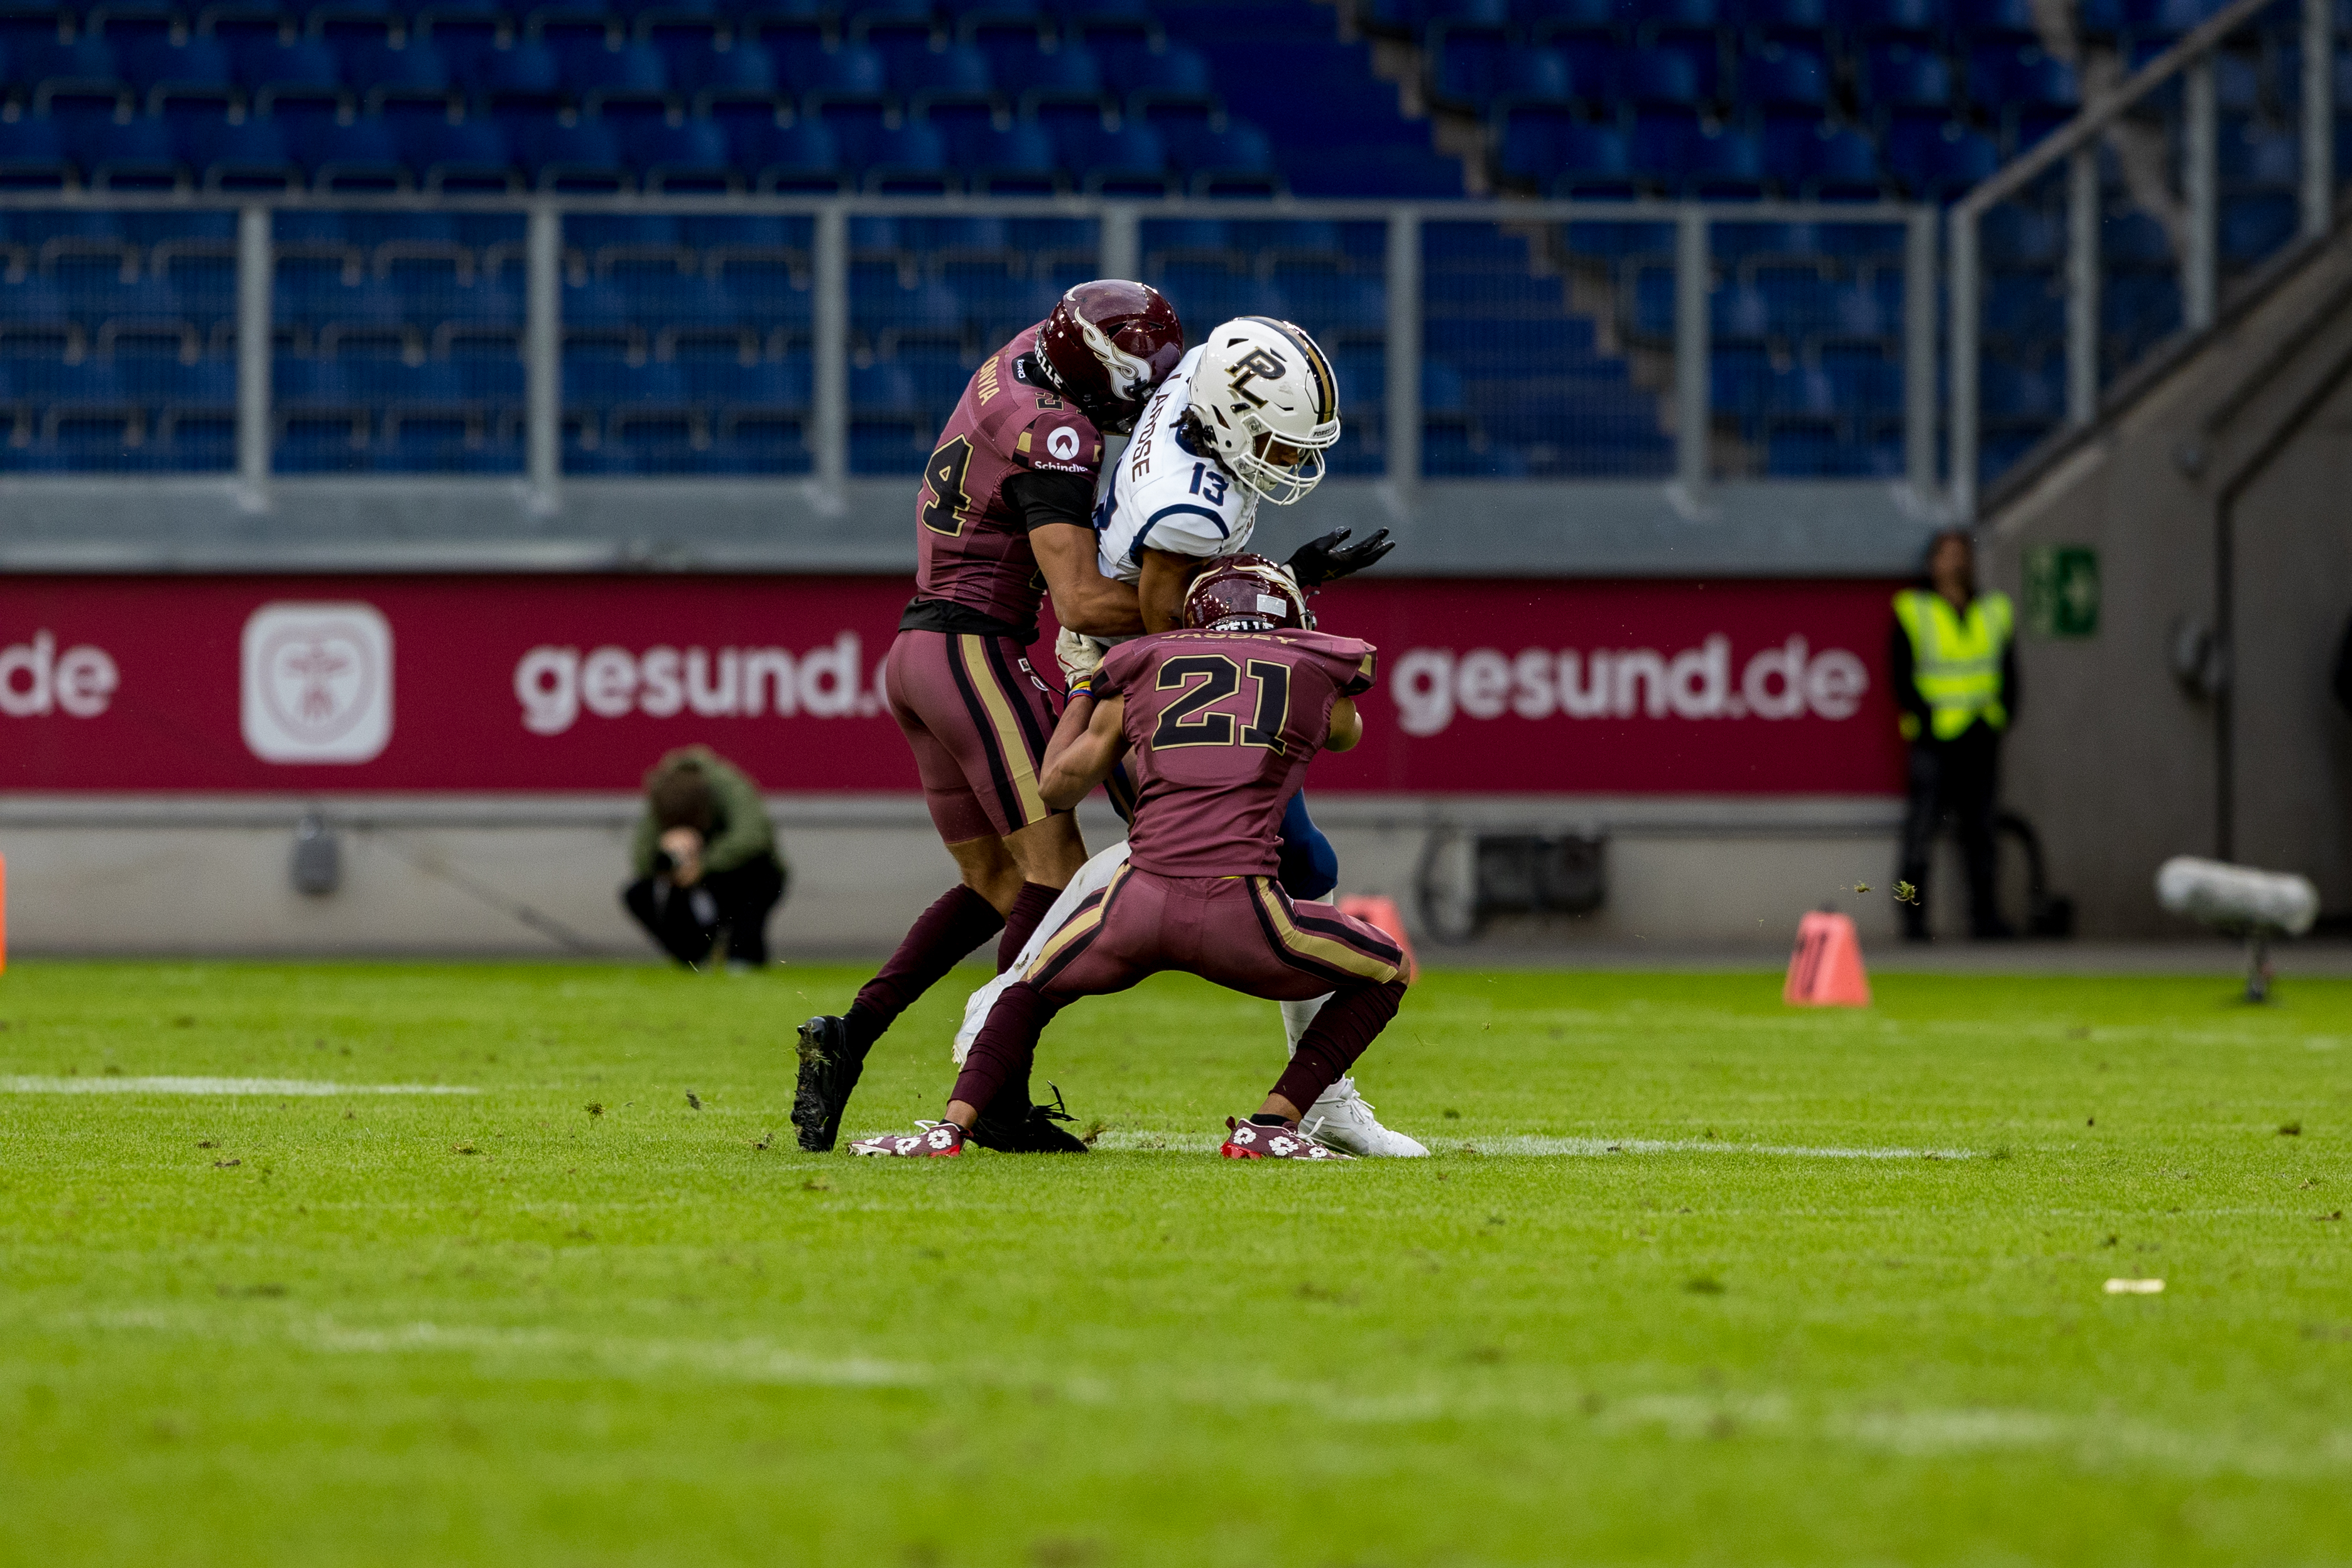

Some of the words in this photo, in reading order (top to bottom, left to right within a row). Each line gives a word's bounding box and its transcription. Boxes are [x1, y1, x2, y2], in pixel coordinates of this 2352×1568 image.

[918, 433, 974, 538] 4
[1034, 460, 1089, 472] Schindle
[1189, 462, 1229, 507] 13
[512, 629, 888, 736] gesund.
[1150, 653, 1292, 757] 21
[1389, 632, 1870, 737] gesund.de
